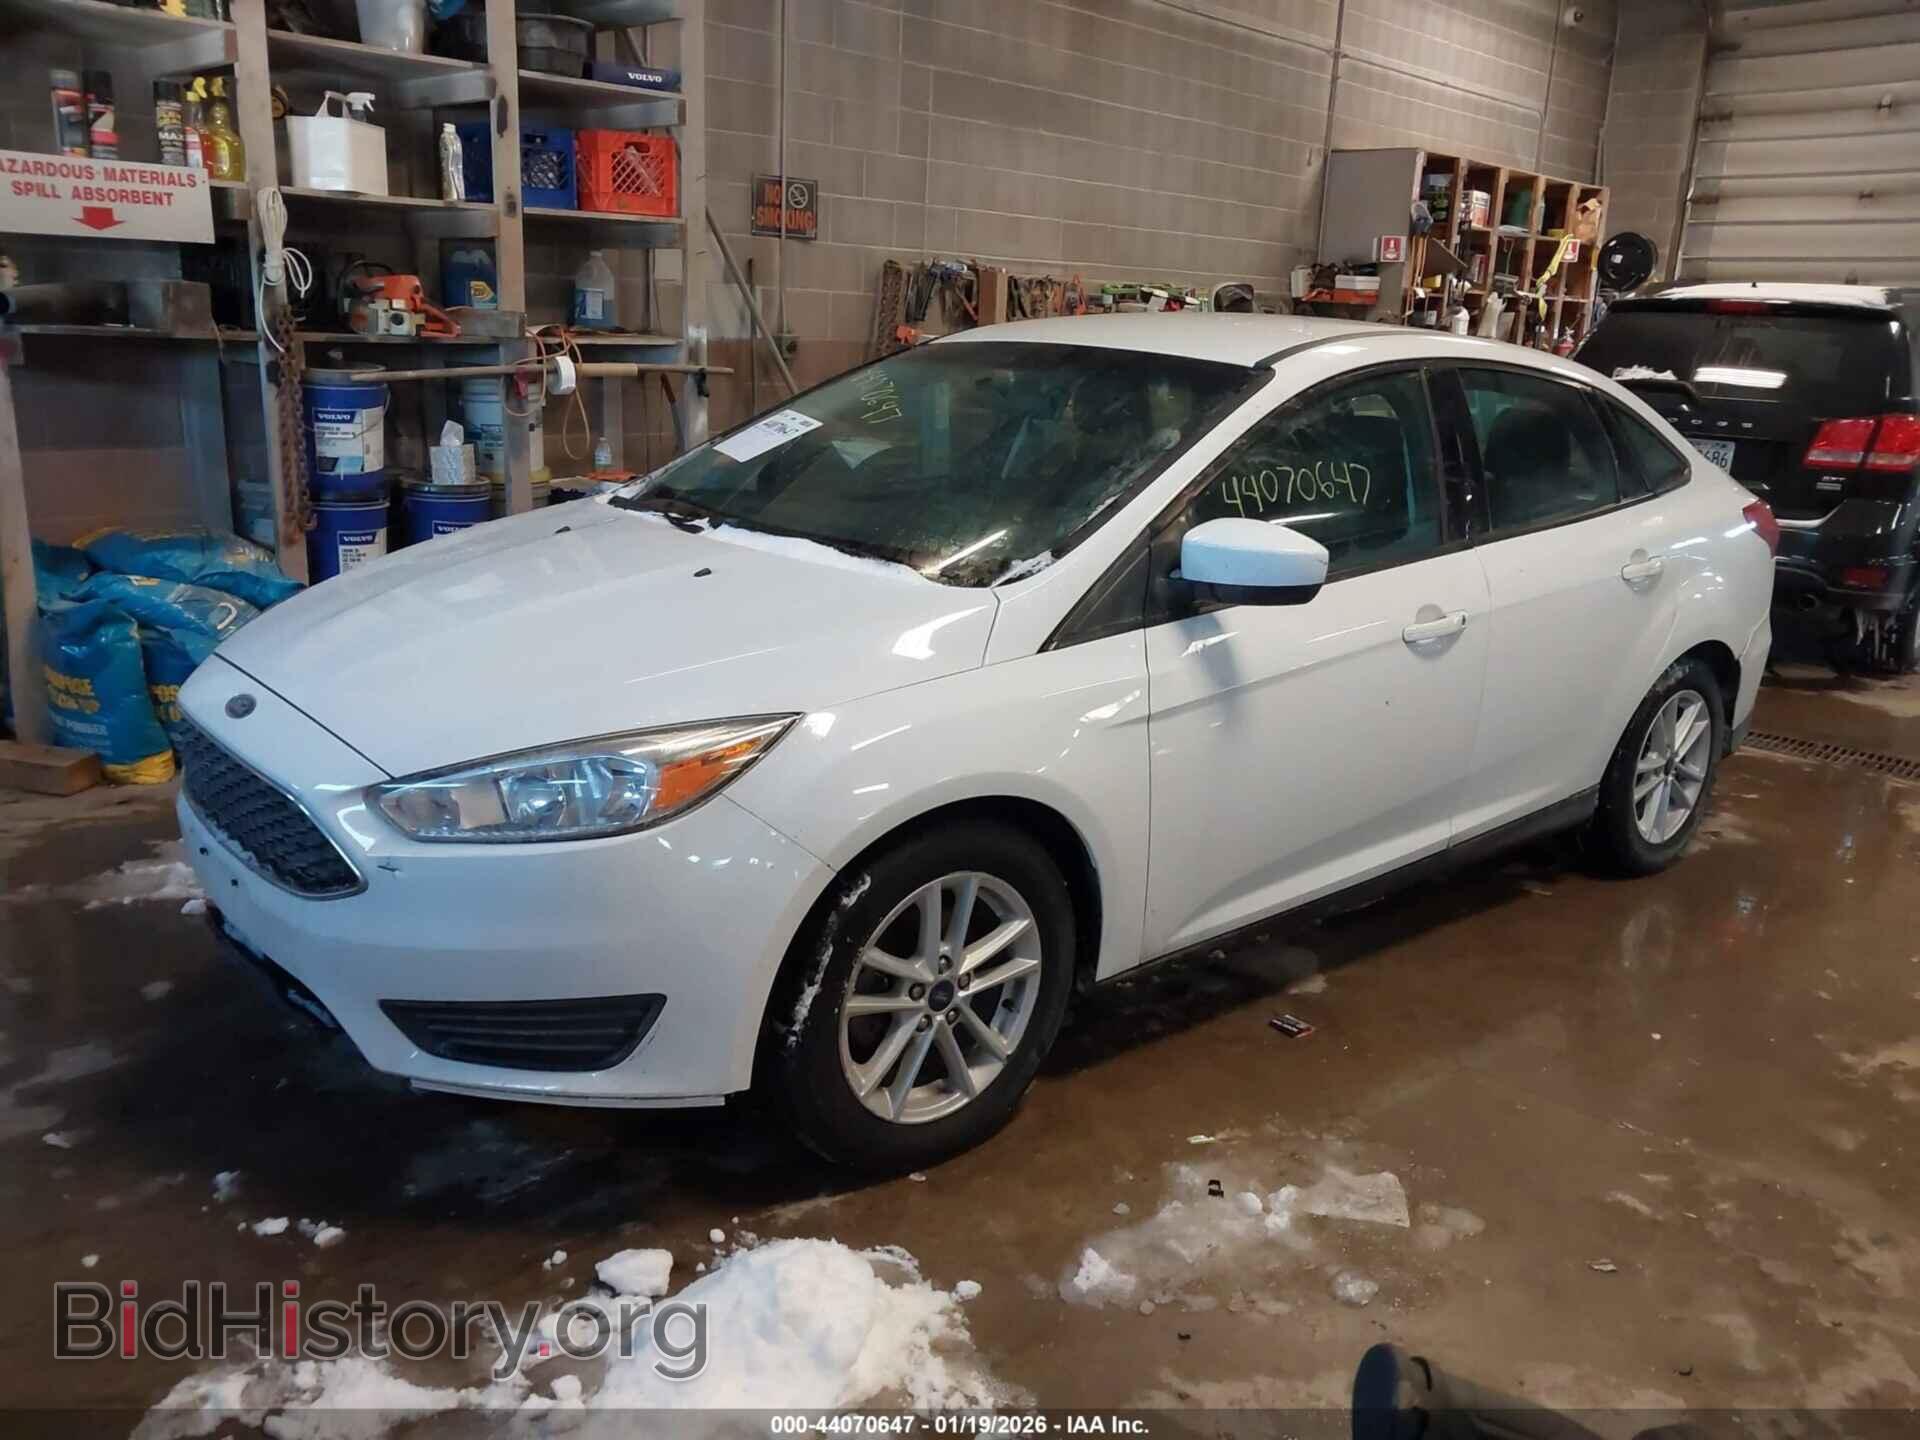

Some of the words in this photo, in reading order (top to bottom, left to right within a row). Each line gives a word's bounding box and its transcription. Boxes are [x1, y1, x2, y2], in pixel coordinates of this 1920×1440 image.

[626, 71, 663, 83] VOLVO
[103, 166, 197, 188] MATERIALS
[11, 180, 62, 199] SPILL
[71, 185, 174, 206] ABSORBENT
[764, 184, 782, 204] NO
[756, 207, 816, 230] SMOKING
[317, 413, 352, 421] VOLVO
[1222, 460, 1372, 519] 44070647
[342, 534, 374, 543] VOLVO
